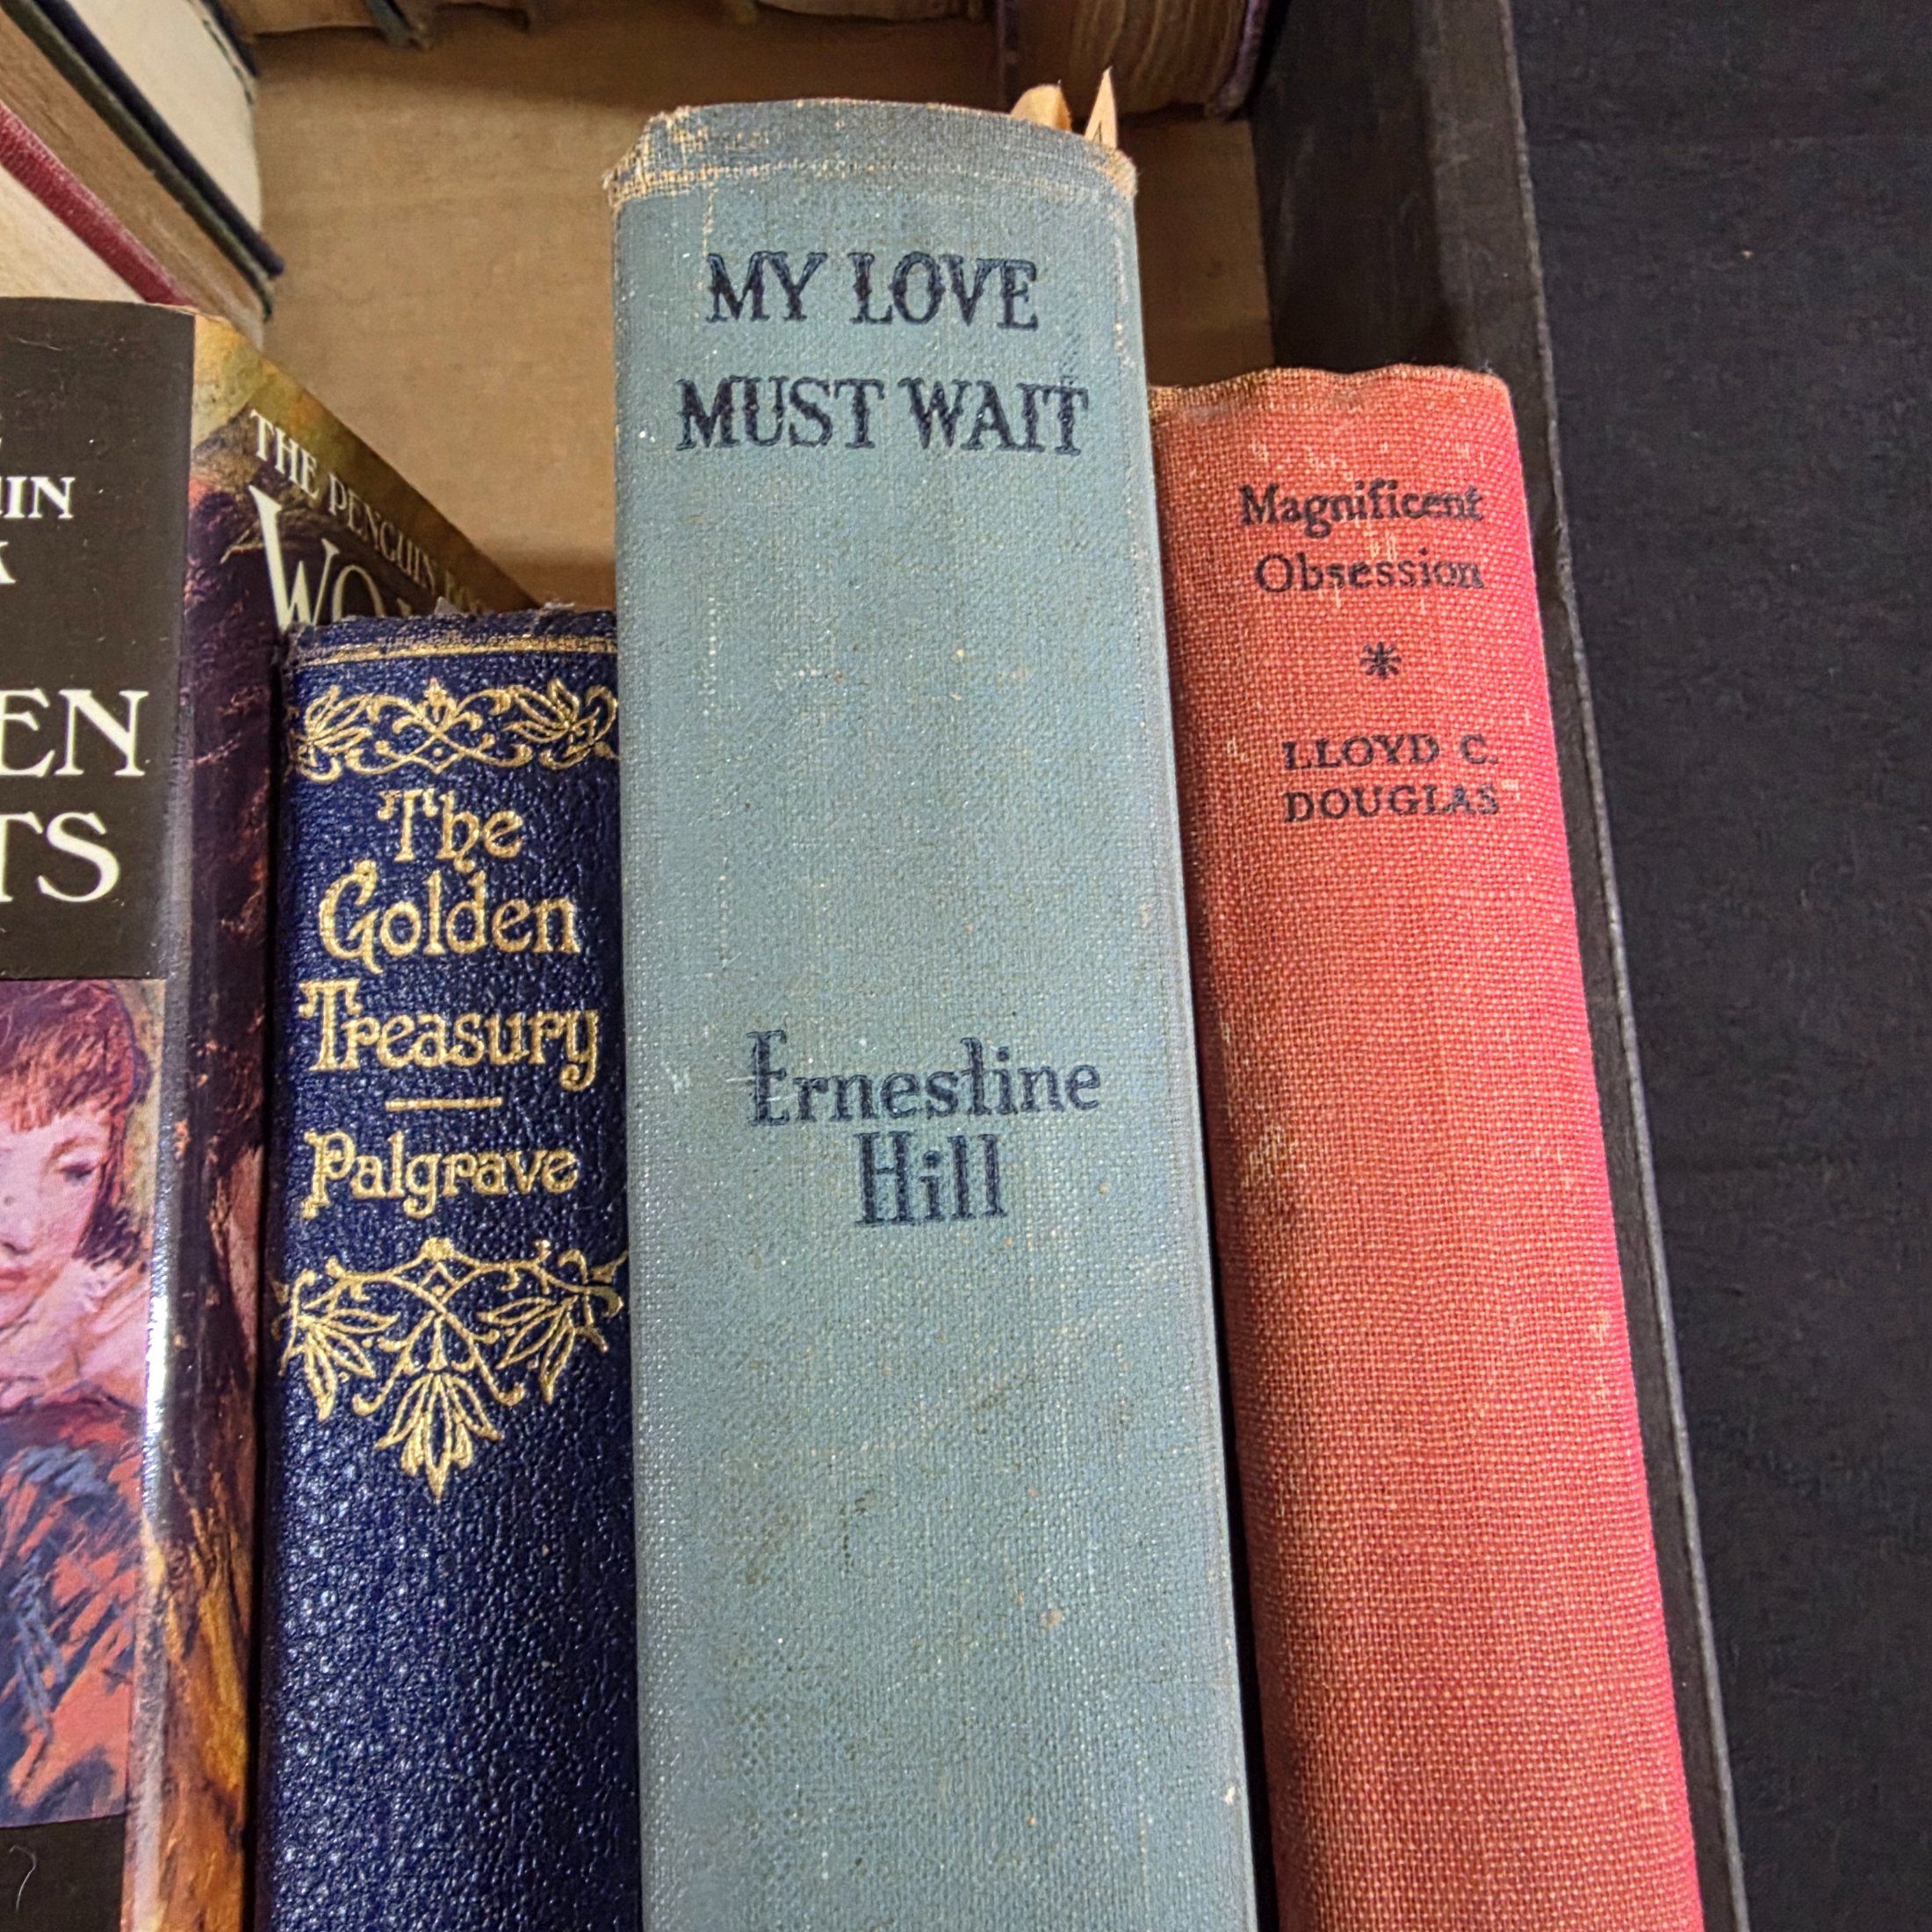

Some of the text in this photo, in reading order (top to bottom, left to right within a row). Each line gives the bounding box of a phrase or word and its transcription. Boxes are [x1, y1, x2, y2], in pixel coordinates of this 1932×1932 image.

[705, 250, 1039, 331] MY LOVE
[250, 408, 319, 499] THE
[675, 375, 1089, 455] MUST WAIT
[0, 476, 76, 520] IN
[1238, 477, 1485, 538] Magnificent
[1254, 546, 1486, 594] Obsession
[1283, 734, 1501, 771] LLOYD C.
[375, 788, 525, 874] The
[1285, 783, 1501, 823] DOUGLAS
[317, 860, 582, 975] Golden
[298, 977, 601, 1092] Treasury
[746, 1028, 1101, 1127] Ernestine
[299, 1129, 580, 1220] Palgrave
[854, 1130, 1009, 1228] Hill
